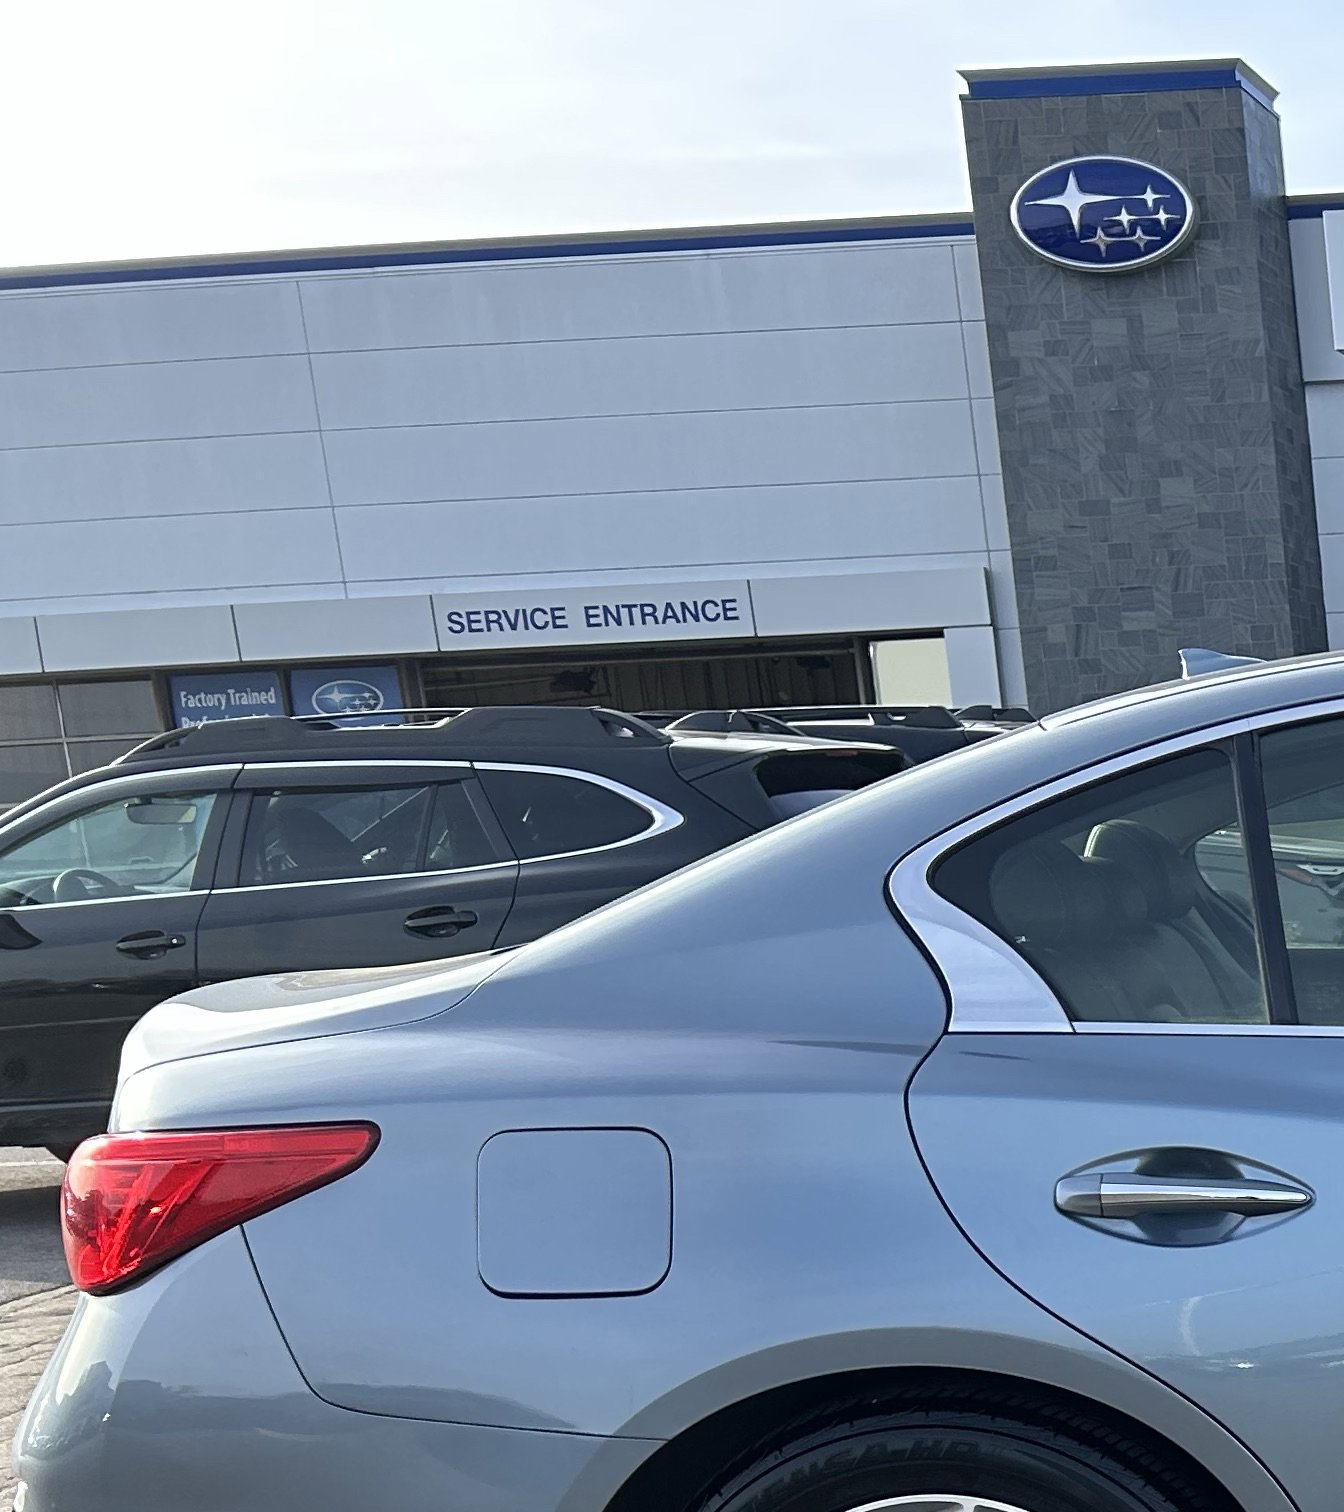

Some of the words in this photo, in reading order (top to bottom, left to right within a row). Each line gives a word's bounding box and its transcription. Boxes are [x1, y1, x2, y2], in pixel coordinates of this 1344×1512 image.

[447, 607, 568, 634] SERVICE
[584, 598, 740, 628] ENTRANCE
[180, 691, 227, 710] Factory
[227, 686, 276, 705] Trained
